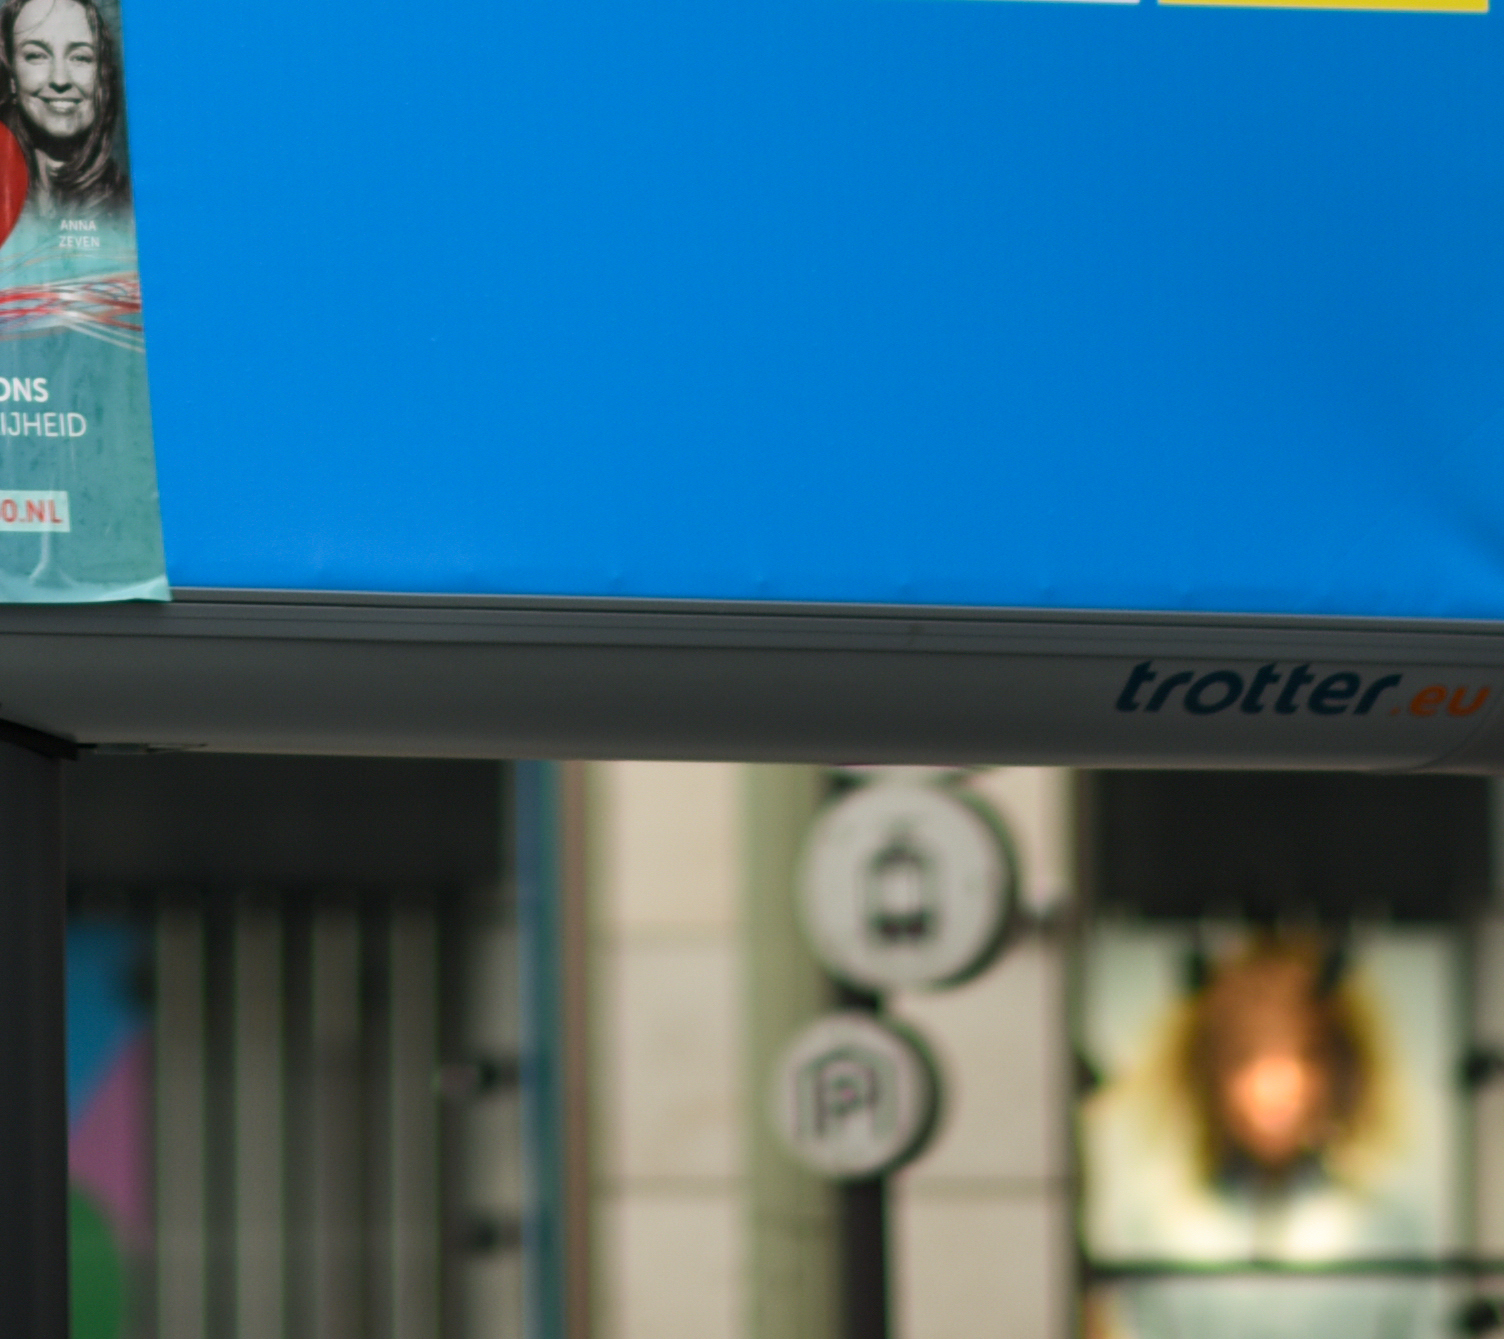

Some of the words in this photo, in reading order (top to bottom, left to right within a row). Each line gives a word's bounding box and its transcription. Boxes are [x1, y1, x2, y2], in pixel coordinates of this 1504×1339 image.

[60, 220, 97, 231] ANNA
[59, 235, 100, 248] ZEVEN
[1114, 659, 1492, 718] trotter.eu
